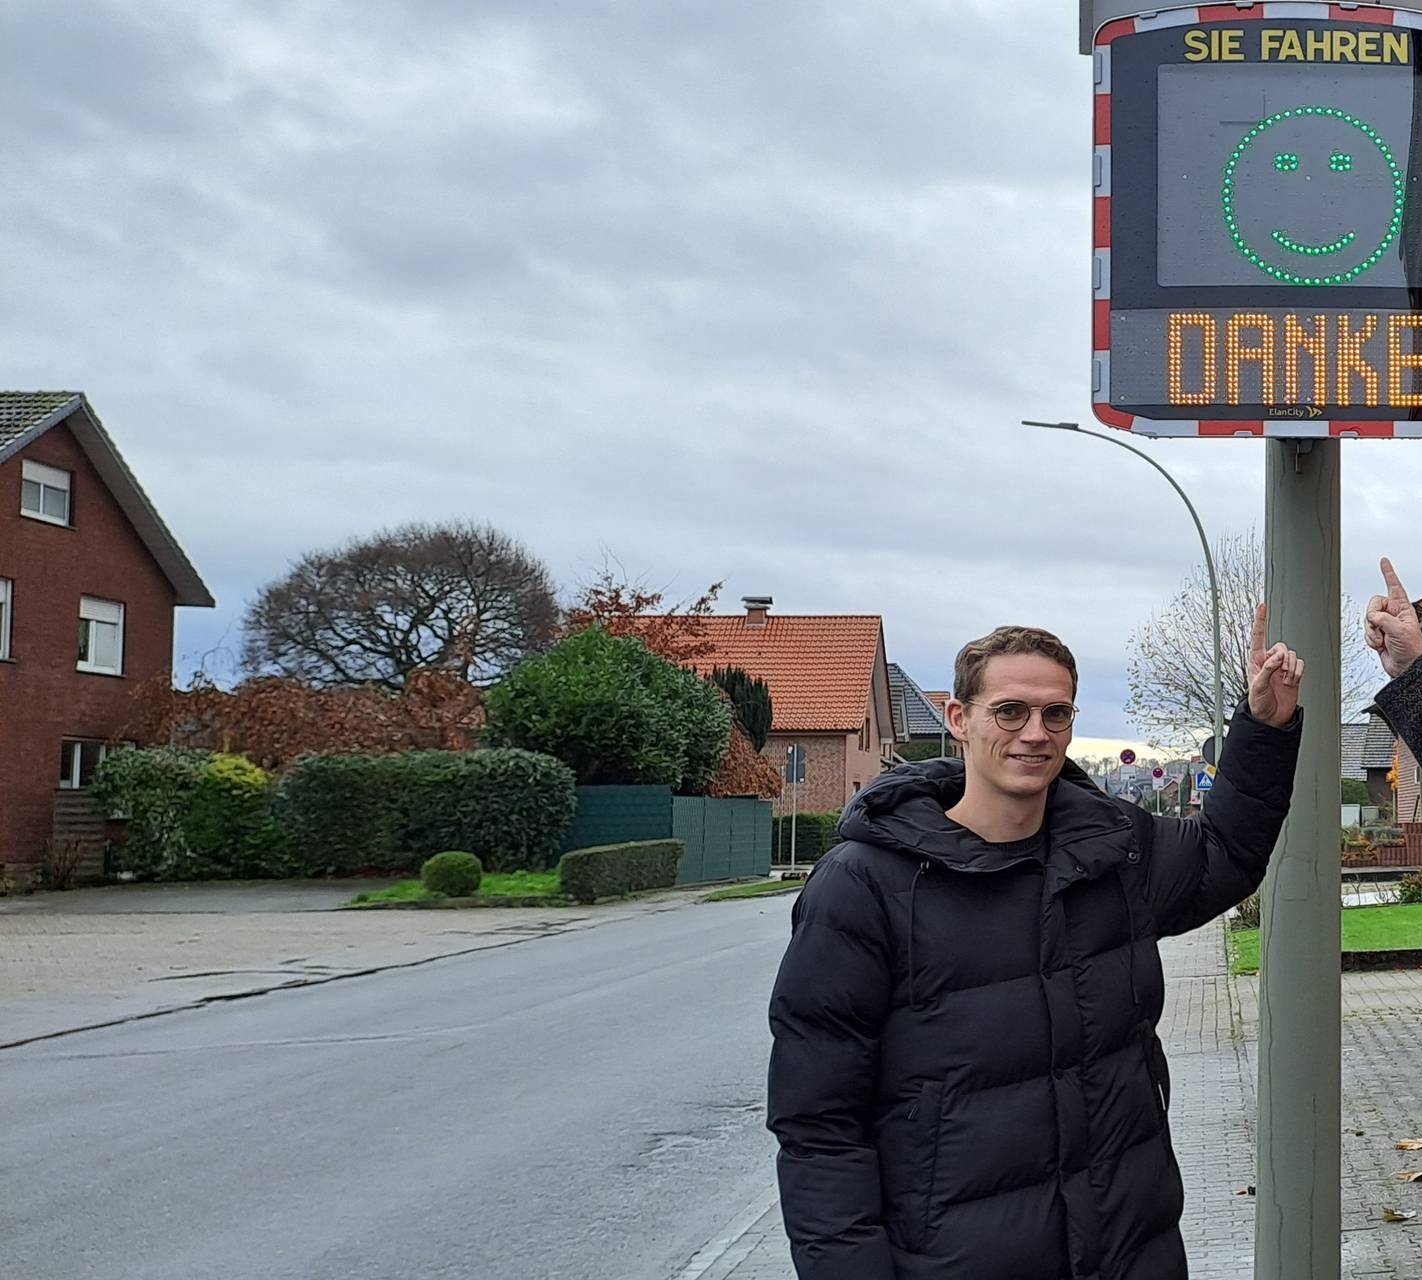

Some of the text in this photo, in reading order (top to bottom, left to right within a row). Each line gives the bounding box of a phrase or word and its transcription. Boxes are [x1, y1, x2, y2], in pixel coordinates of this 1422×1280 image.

[1184, 30, 1409, 64] SIE FAHREN
[1269, 408, 1305, 418] ElanCity
